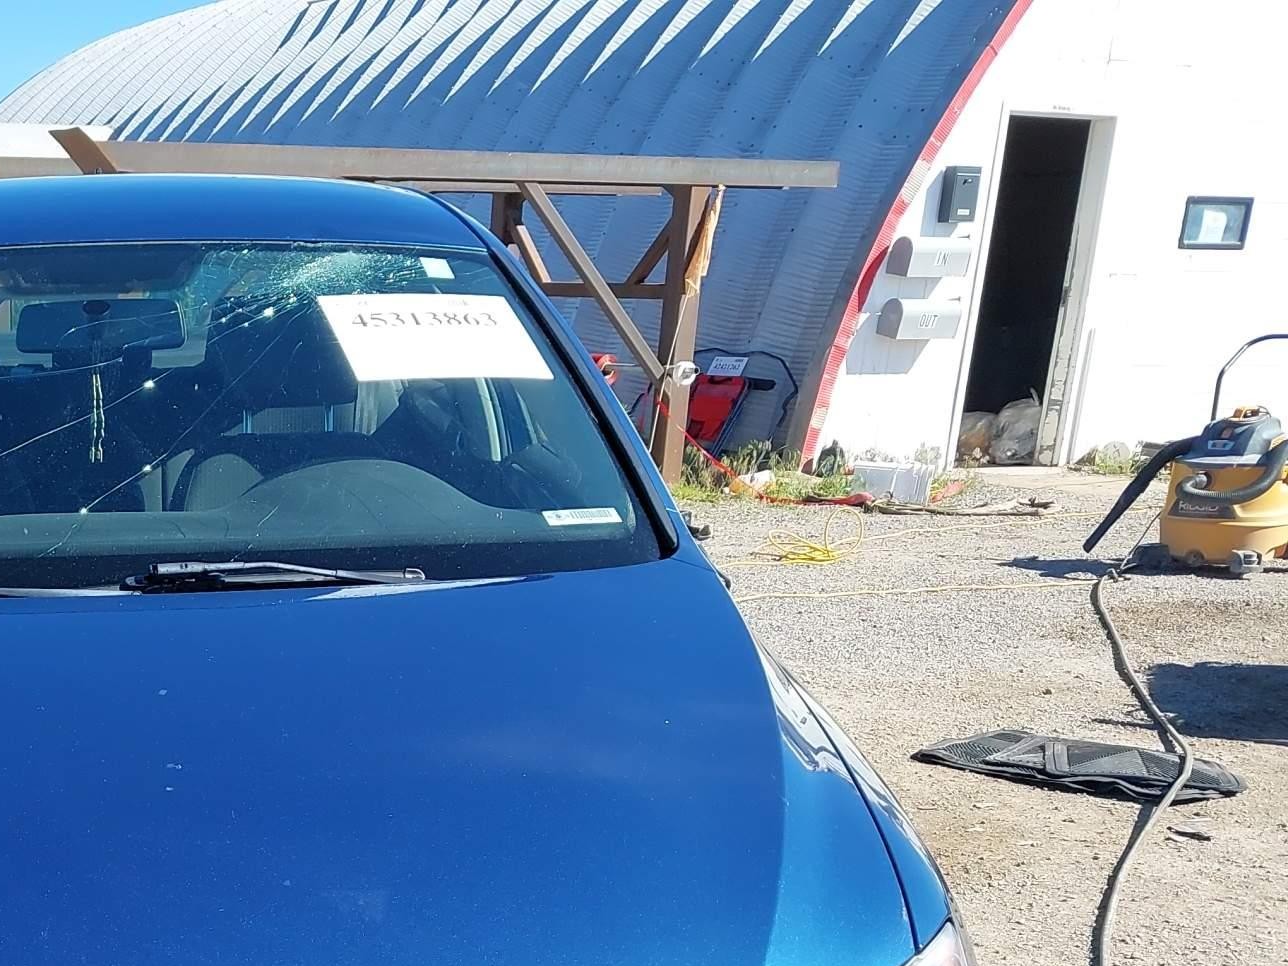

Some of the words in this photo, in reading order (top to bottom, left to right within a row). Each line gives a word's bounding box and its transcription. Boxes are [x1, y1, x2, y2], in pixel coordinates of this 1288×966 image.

[936, 250, 951, 266] IN
[351, 311, 499, 328] 45313863
[919, 313, 939, 328] OUT
